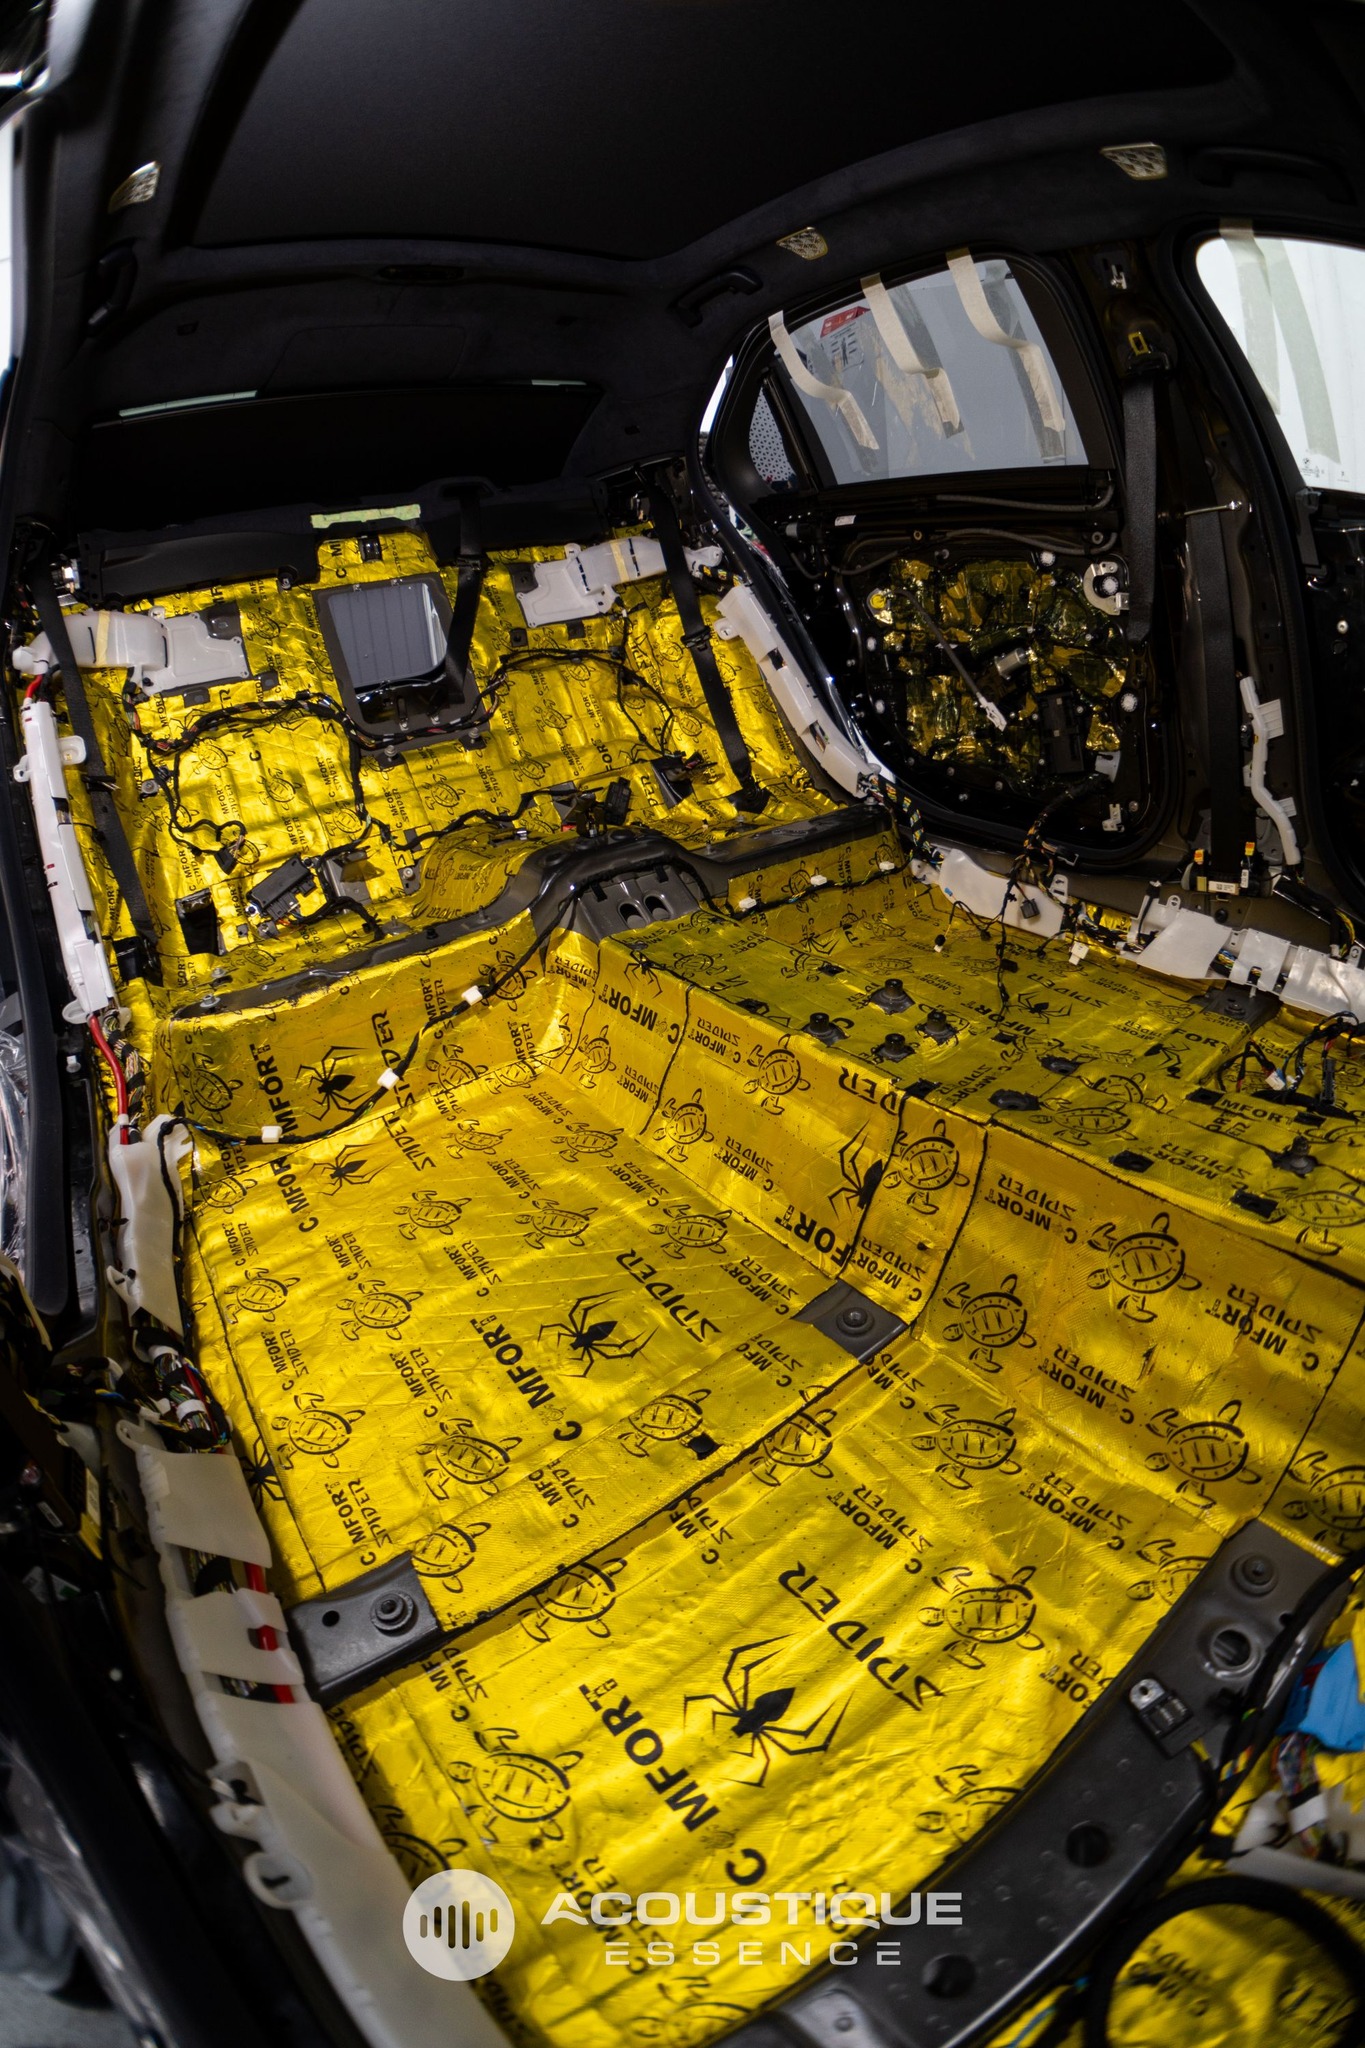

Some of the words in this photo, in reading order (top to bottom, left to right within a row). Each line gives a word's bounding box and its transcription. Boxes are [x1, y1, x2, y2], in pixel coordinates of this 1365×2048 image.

[1026, 973, 1109, 1009] SPIDER
[697, 1016, 741, 1047] SPIDER
[725, 1136, 774, 1173] SPIDER
[998, 1173, 1077, 1221] SPIDER
[740, 1256, 799, 1301] SPIDER
[861, 1236, 927, 1282] SPIDER
[616, 1248, 722, 1343] SPIDER
[1227, 1283, 1323, 1344] SPIDER
[1054, 1344, 1137, 1402] SPIDER
[348, 1478, 393, 1548] SPIDER
[853, 1484, 934, 1554] SPIDER
[1043, 1471, 1133, 1531] SPIDER
[778, 1561, 946, 1711] SPIDER
[1039, 1665, 1093, 1708] ORT
